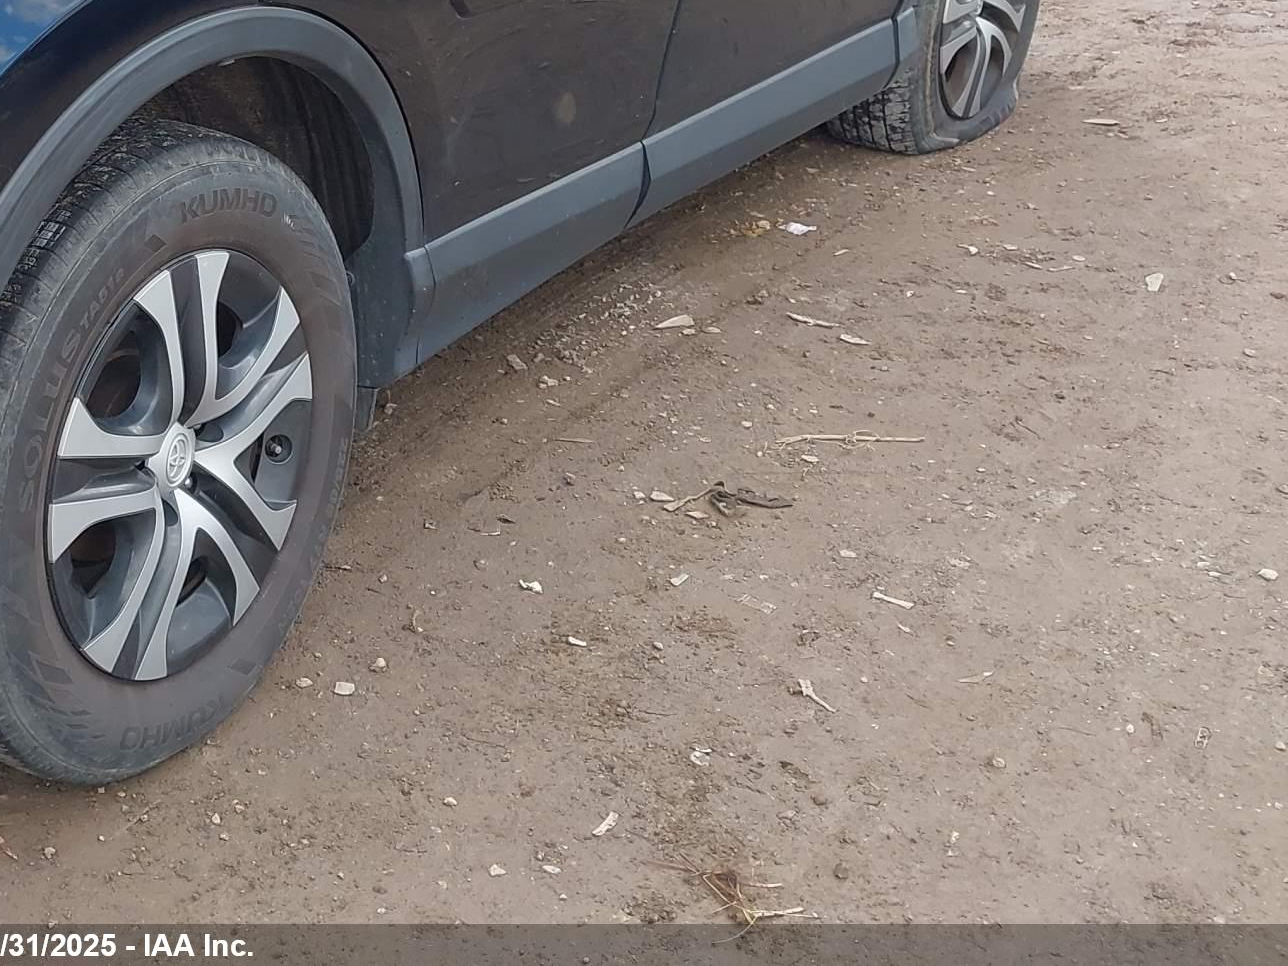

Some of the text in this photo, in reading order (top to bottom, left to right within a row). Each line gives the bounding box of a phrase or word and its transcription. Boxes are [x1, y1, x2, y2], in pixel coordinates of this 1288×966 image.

[179, 186, 279, 223] KUMHO
[18, 329, 81, 514] SOLUS
[119, 696, 227, 752] KUMHO
